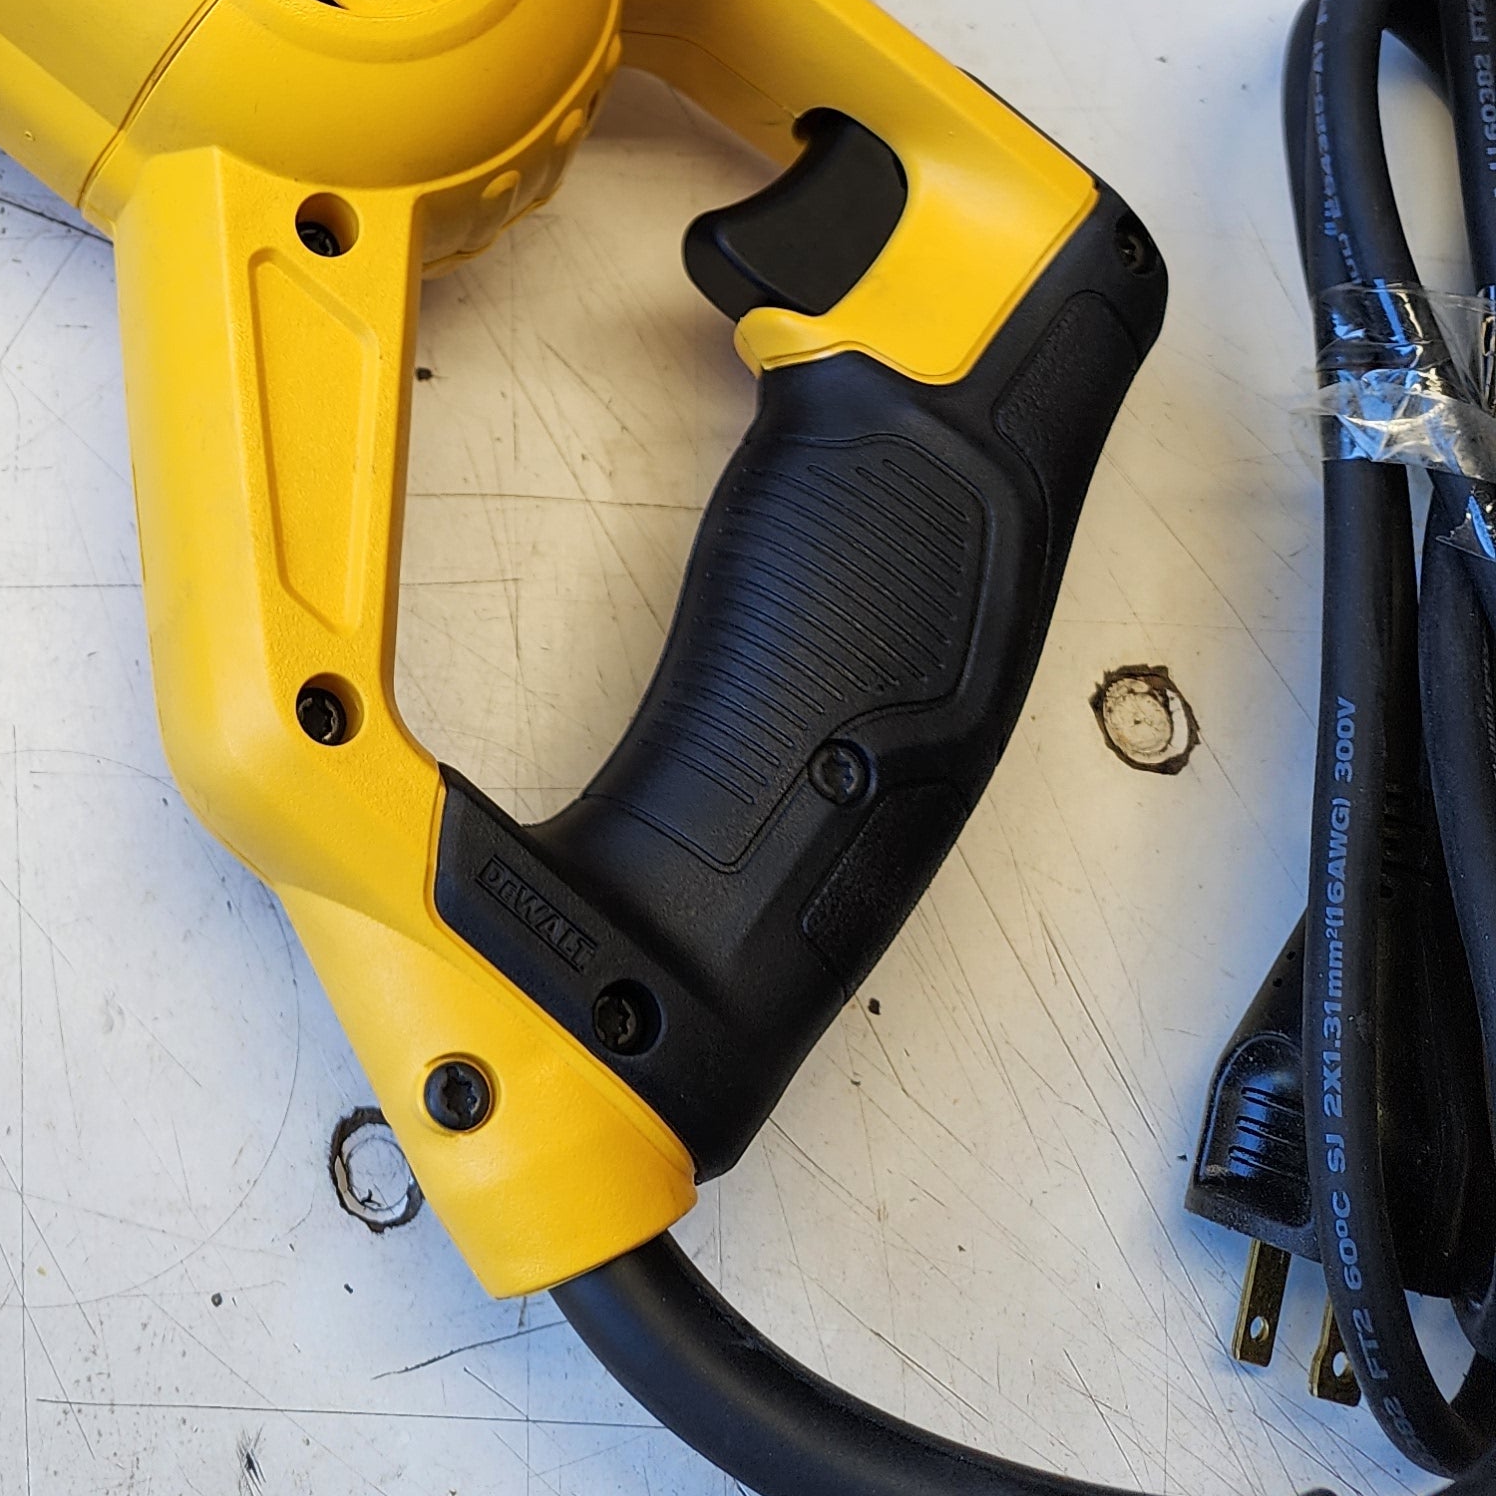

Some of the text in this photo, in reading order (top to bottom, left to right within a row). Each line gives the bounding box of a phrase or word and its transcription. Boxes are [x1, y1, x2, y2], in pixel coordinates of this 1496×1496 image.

[1335, 696, 1356, 781] 300V
[1324, 1133, 1345, 1172] SJ
[1352, 1307, 1389, 1378] FT2
